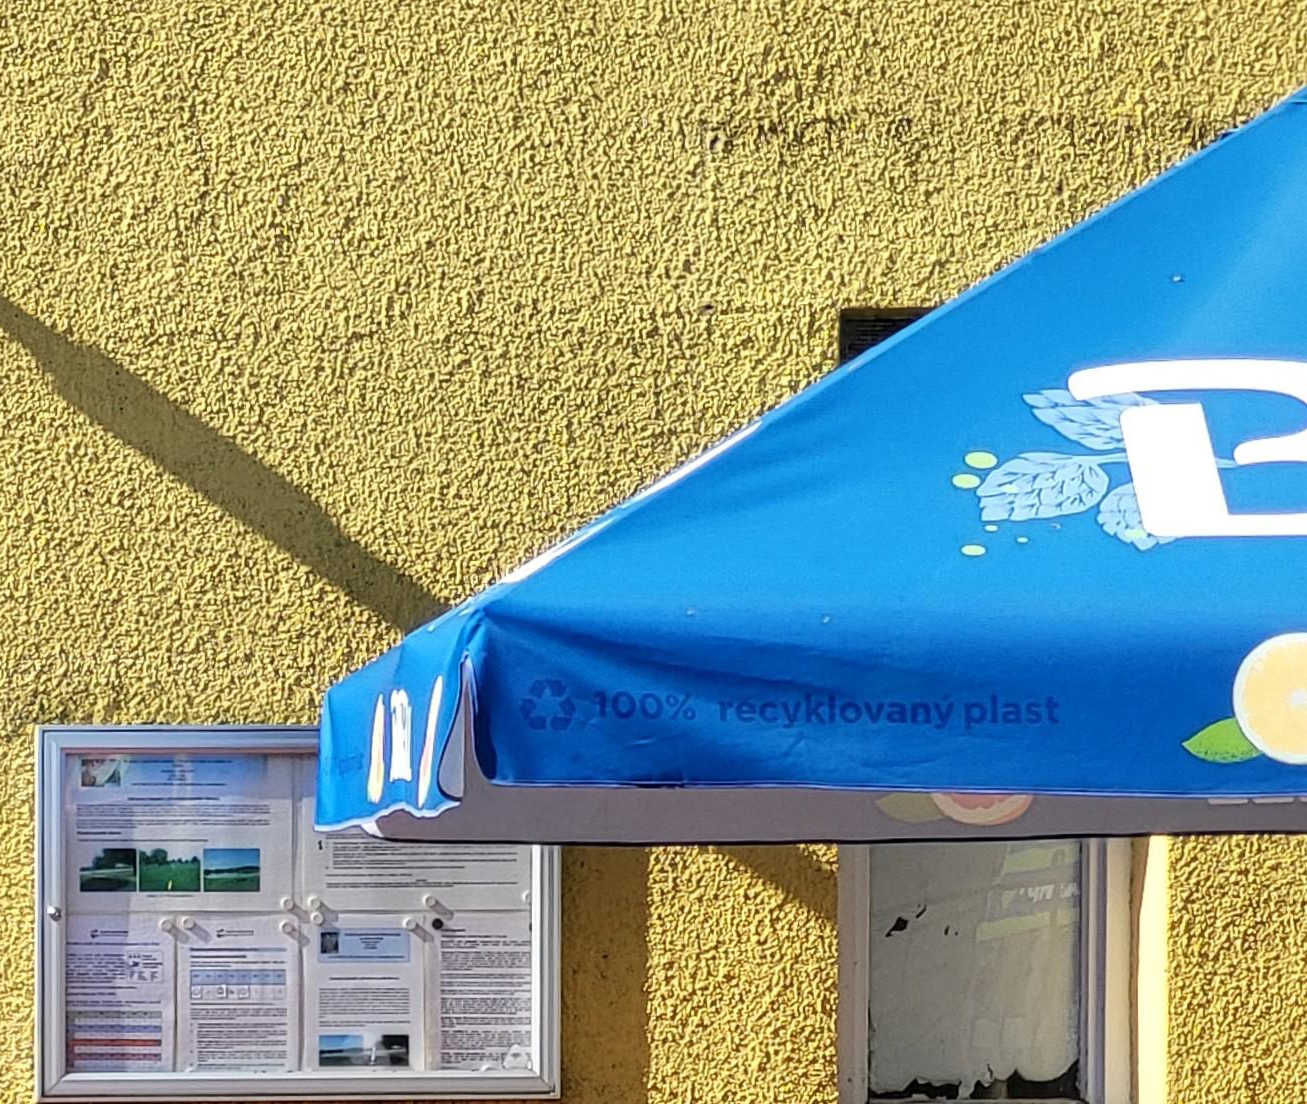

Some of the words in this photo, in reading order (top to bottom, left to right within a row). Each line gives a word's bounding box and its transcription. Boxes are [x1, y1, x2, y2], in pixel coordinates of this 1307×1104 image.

[593, 690, 697, 722] 100%
[718, 693, 954, 730] recyklovaný
[962, 694, 1060, 730] plast
